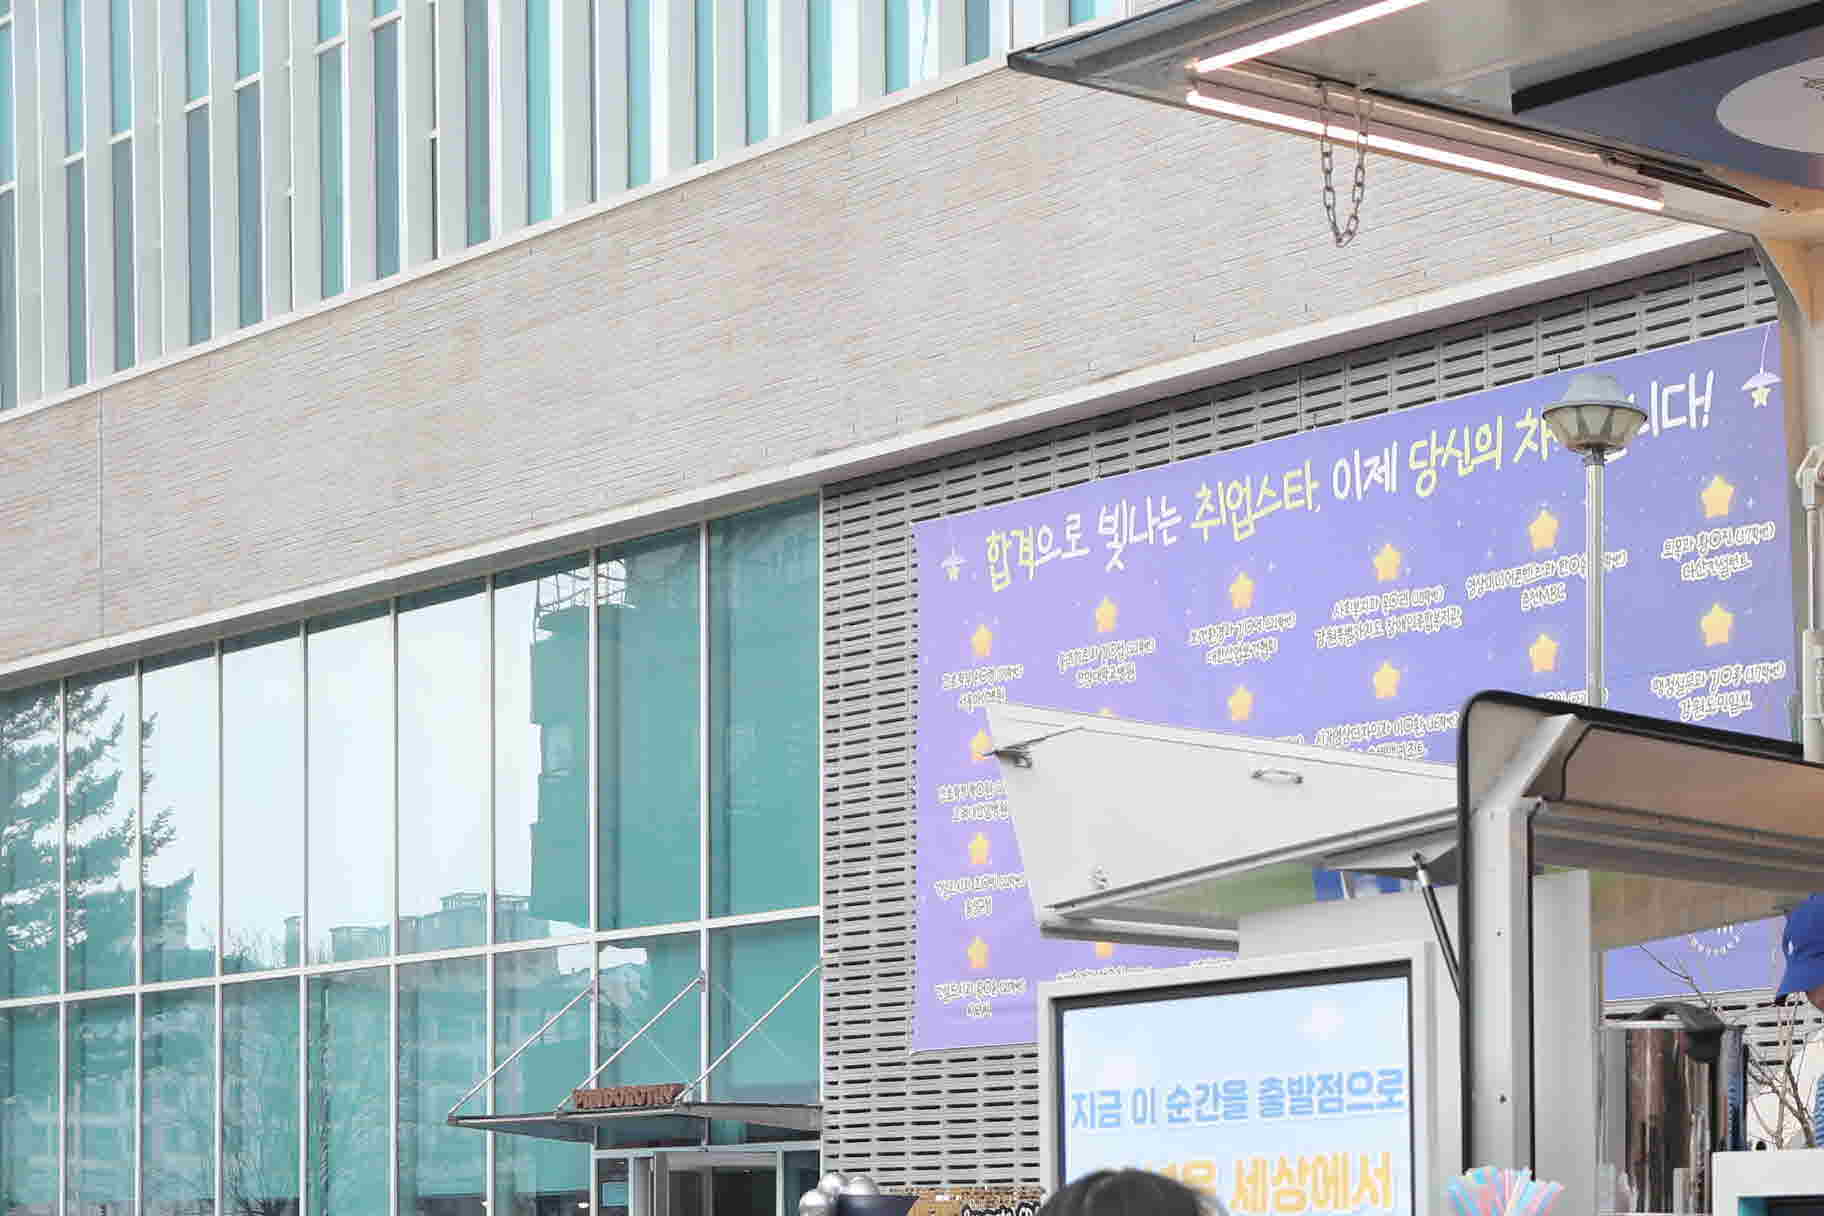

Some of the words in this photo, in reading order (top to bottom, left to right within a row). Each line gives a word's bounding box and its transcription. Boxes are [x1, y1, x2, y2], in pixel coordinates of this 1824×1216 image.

[985, 511, 1091, 593] 합격으로
[1097, 495, 1183, 573] 빛나는
[1331, 440, 1399, 501] 이제
[1407, 415, 1504, 498] 당신의
[1512, 369, 1716, 464] 차니다!
[1071, 1089, 1123, 1130] 지금
[1131, 1087, 1156, 1125] 이
[1166, 1078, 1249, 1125] 순간을
[1257, 1066, 1408, 1120] 출발점으로
[1231, 1150, 1393, 1214] 세상에서
